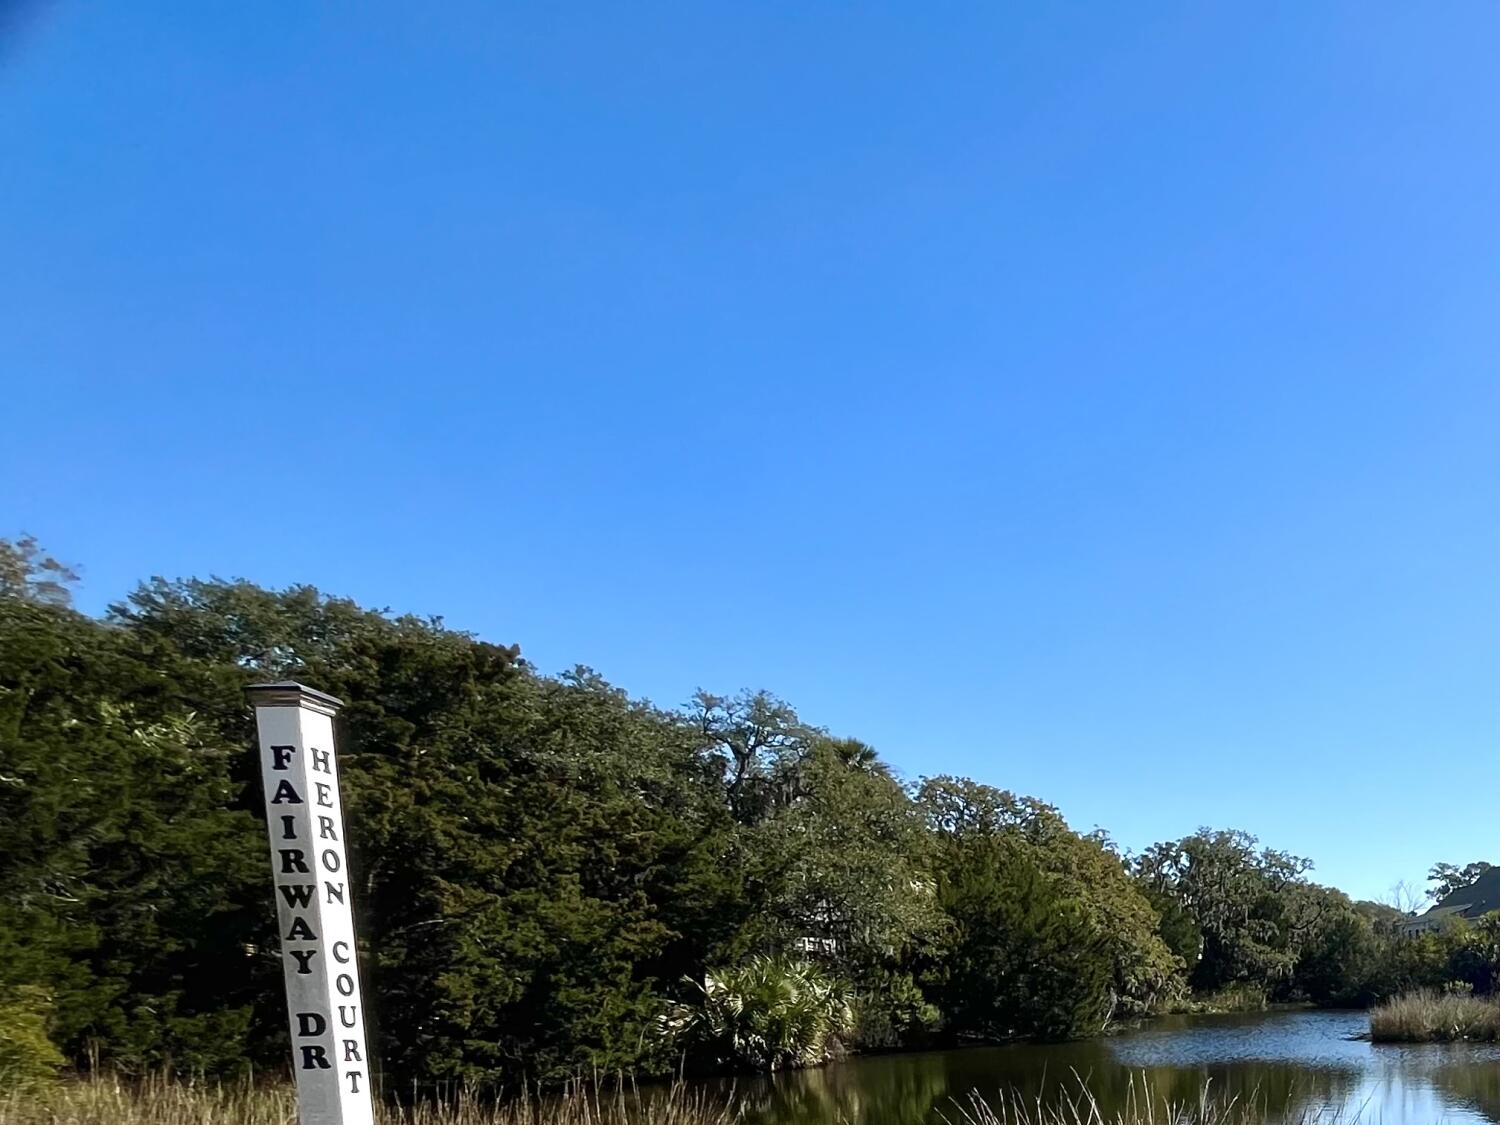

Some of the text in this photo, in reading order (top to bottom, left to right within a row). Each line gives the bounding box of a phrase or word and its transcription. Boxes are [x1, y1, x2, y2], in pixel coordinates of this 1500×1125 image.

[270, 745, 332, 1069] FAIRWAY DR
[310, 747, 362, 1094] HERON COURT
